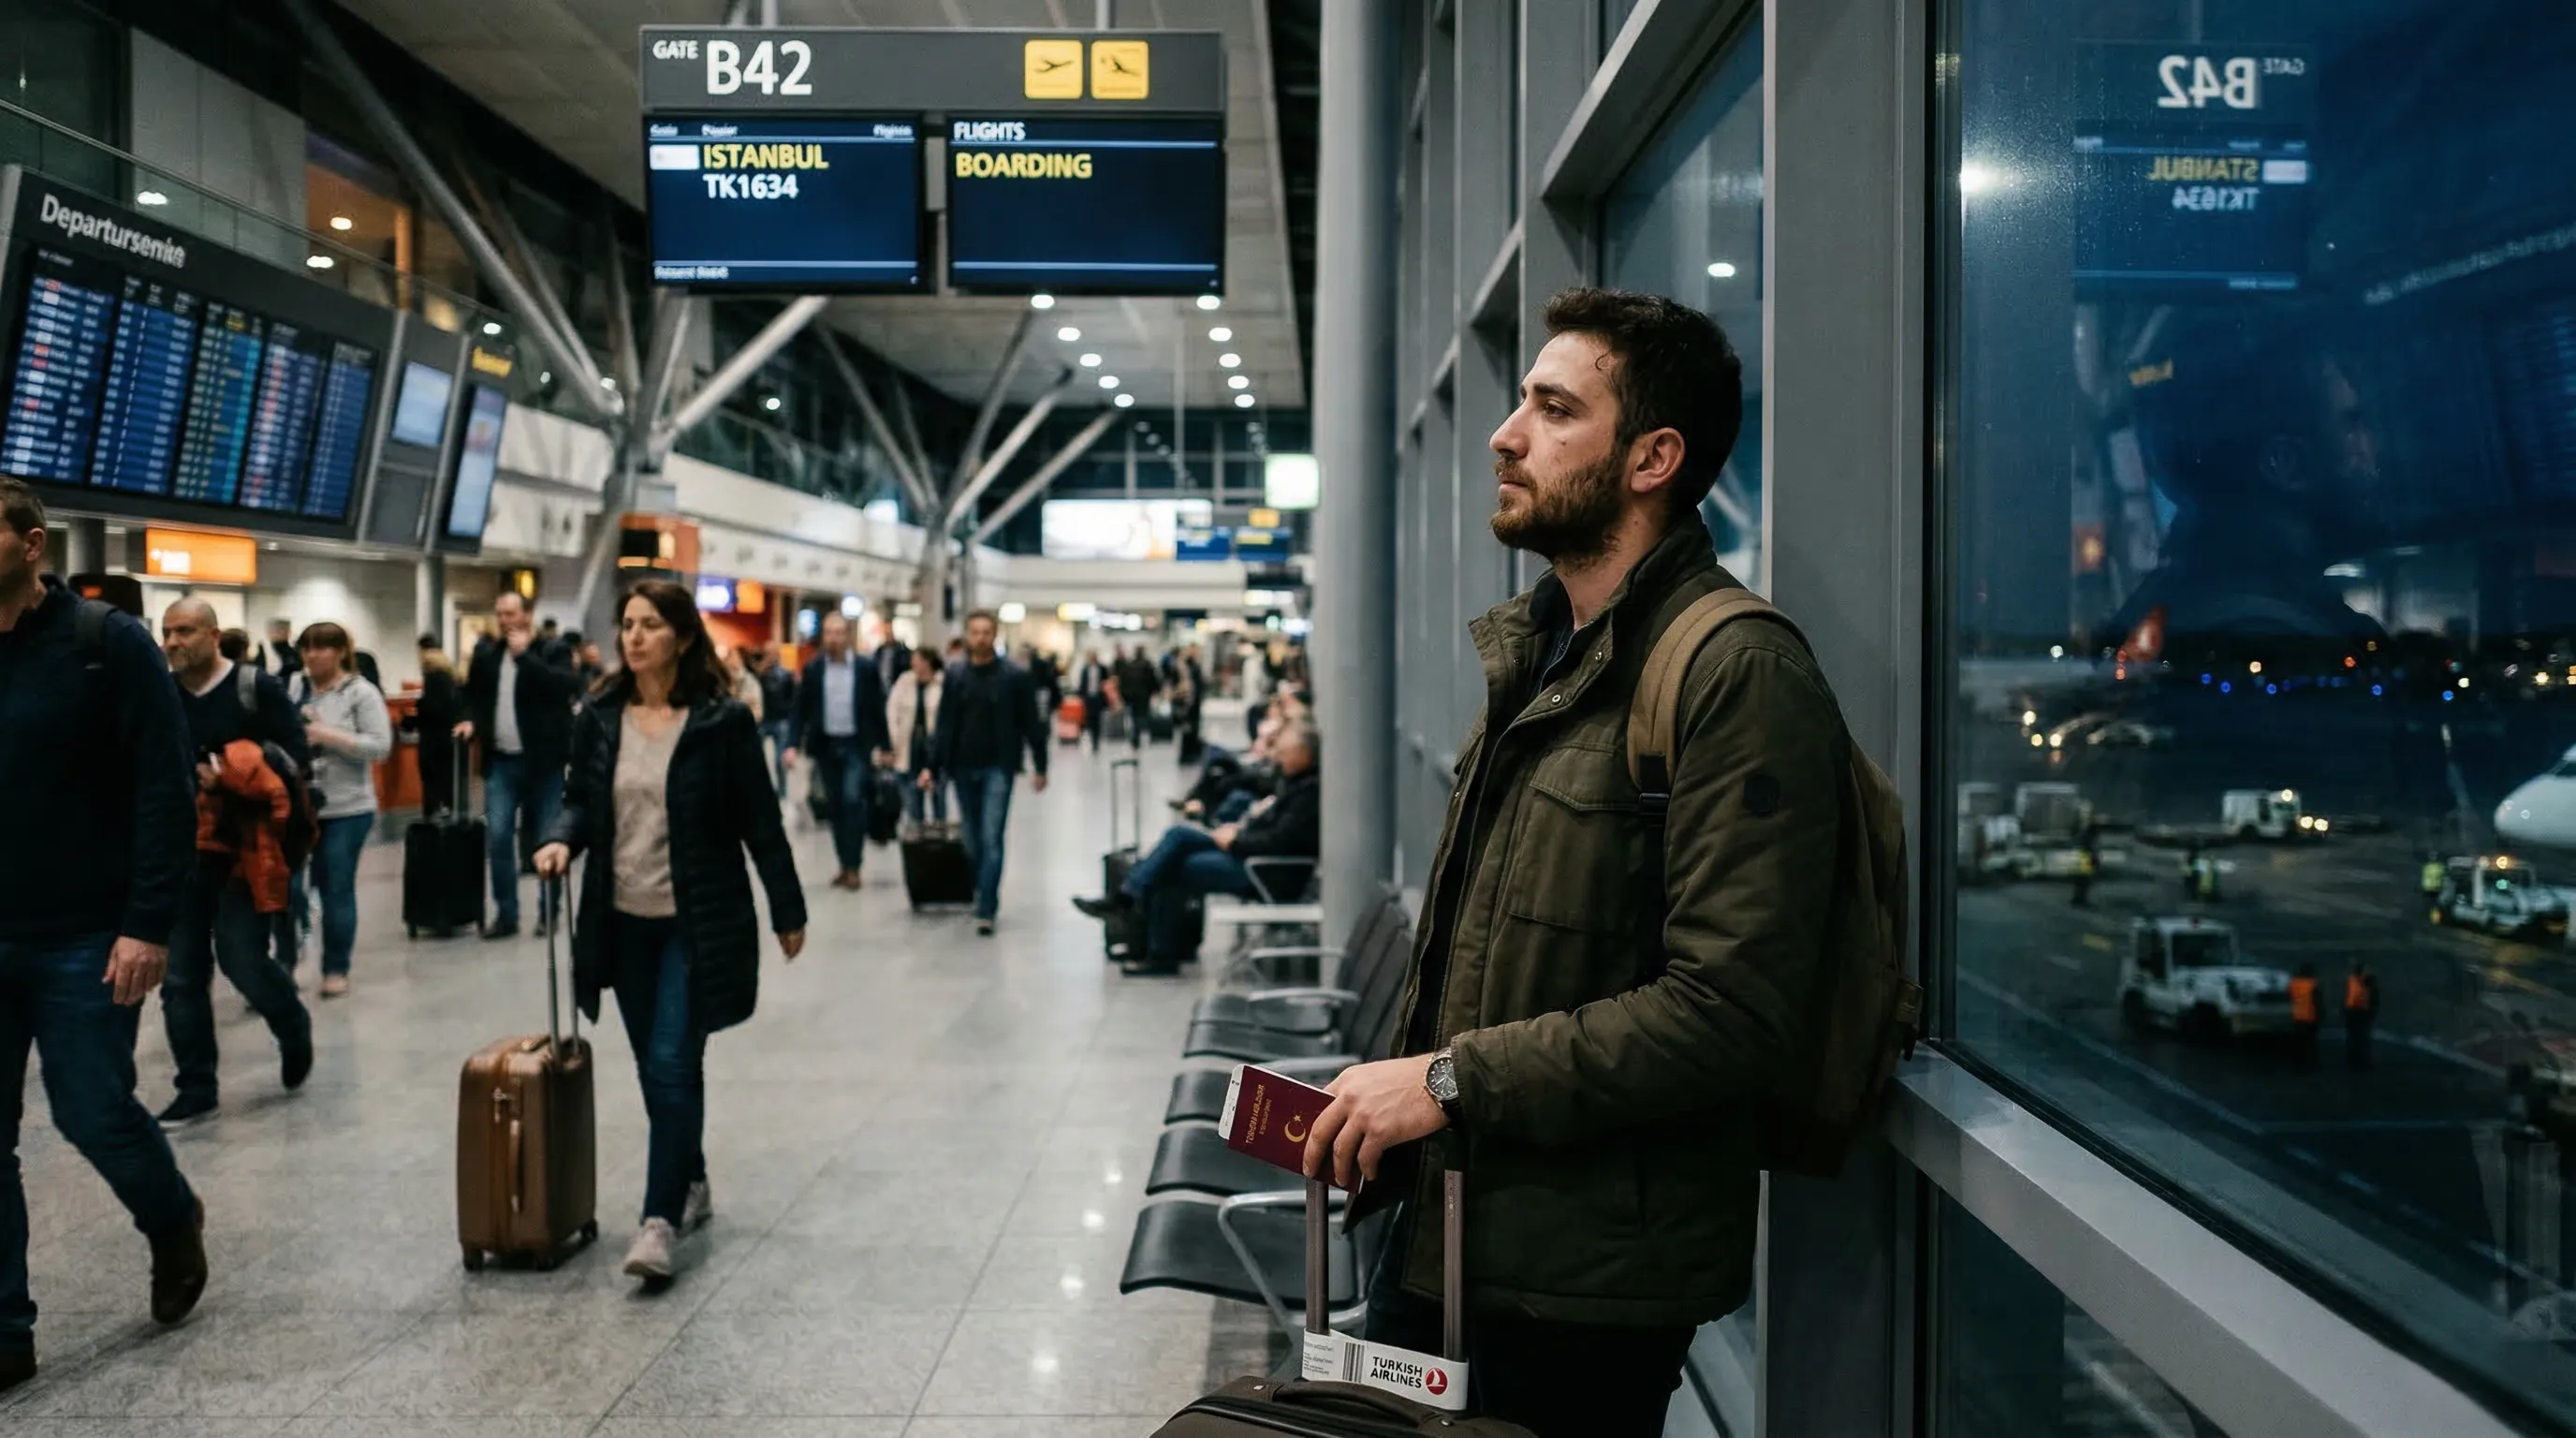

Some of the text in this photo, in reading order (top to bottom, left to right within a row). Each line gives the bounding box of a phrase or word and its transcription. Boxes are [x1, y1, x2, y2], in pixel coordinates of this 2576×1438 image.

[652, 40, 812, 95] GATE B42
[953, 122, 1026, 141] FLIGHTS
[703, 144, 829, 169] ISTANBUL
[956, 152, 1093, 179] BOARDING
[702, 173, 798, 199] TK1634
[1369, 1367, 1422, 1389] AIRLINES
[1372, 1356, 1423, 1377] TURKISH
